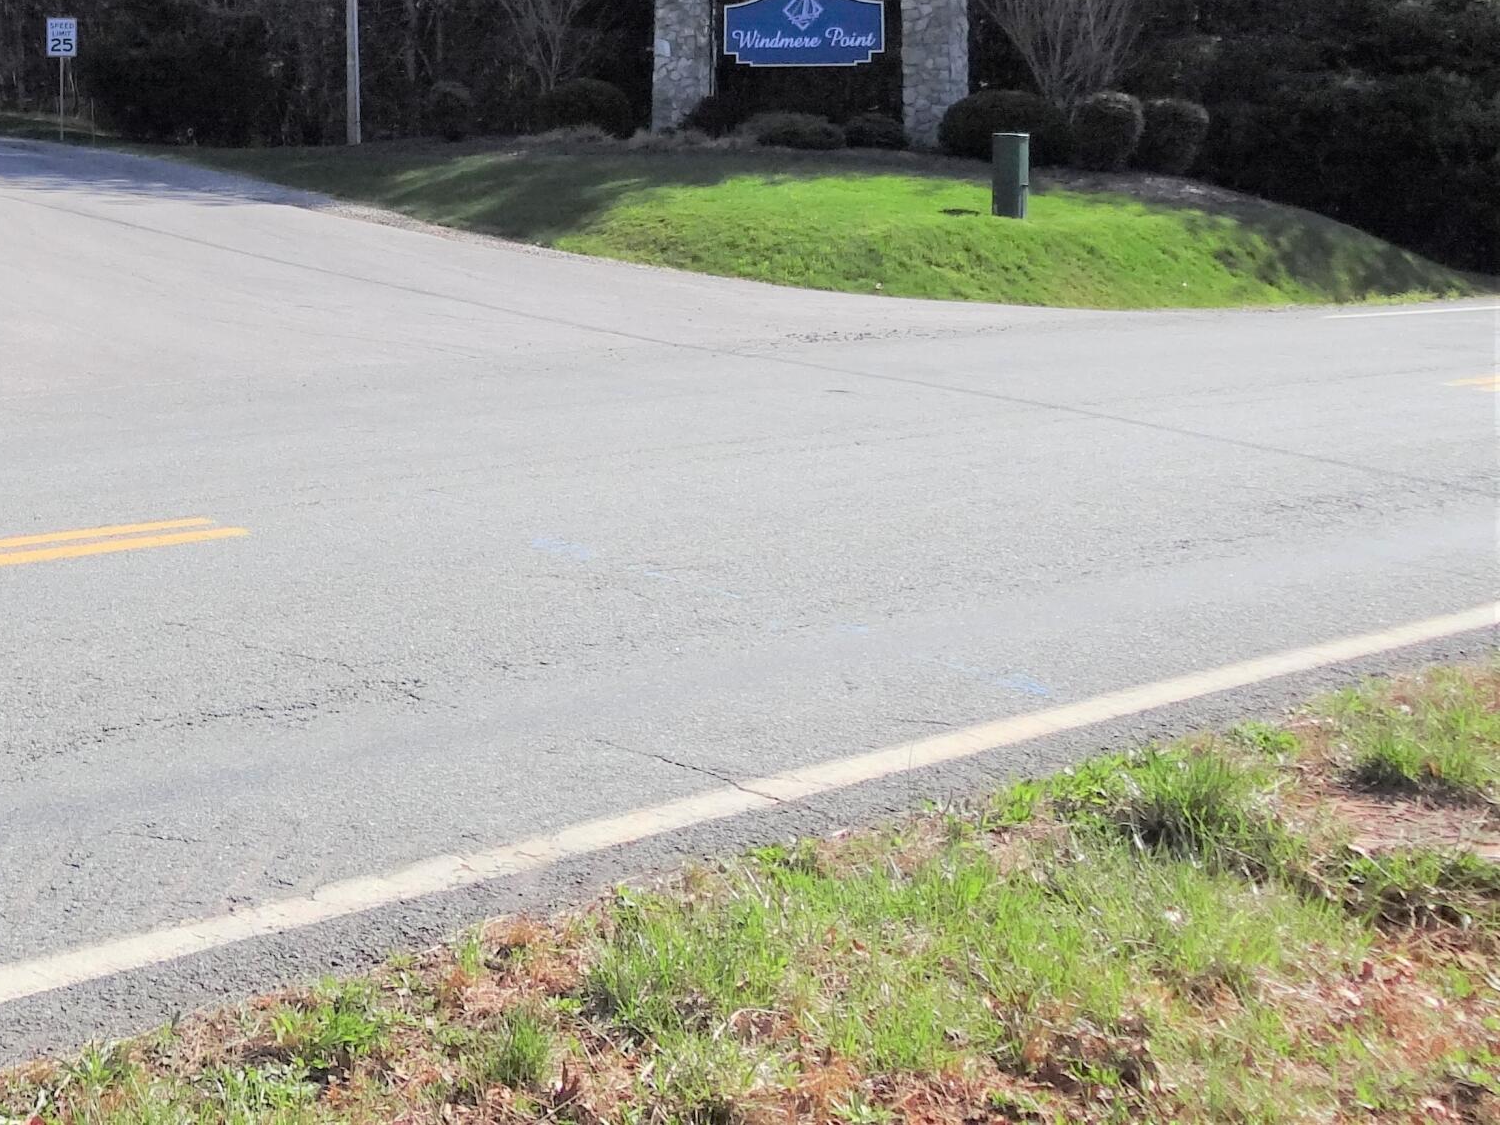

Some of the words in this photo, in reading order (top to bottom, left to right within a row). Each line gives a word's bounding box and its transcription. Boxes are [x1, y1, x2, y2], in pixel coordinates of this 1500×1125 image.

[50, 38, 73, 52] 25
[731, 29, 822, 49] Windmere
[824, 26, 876, 48] Point
